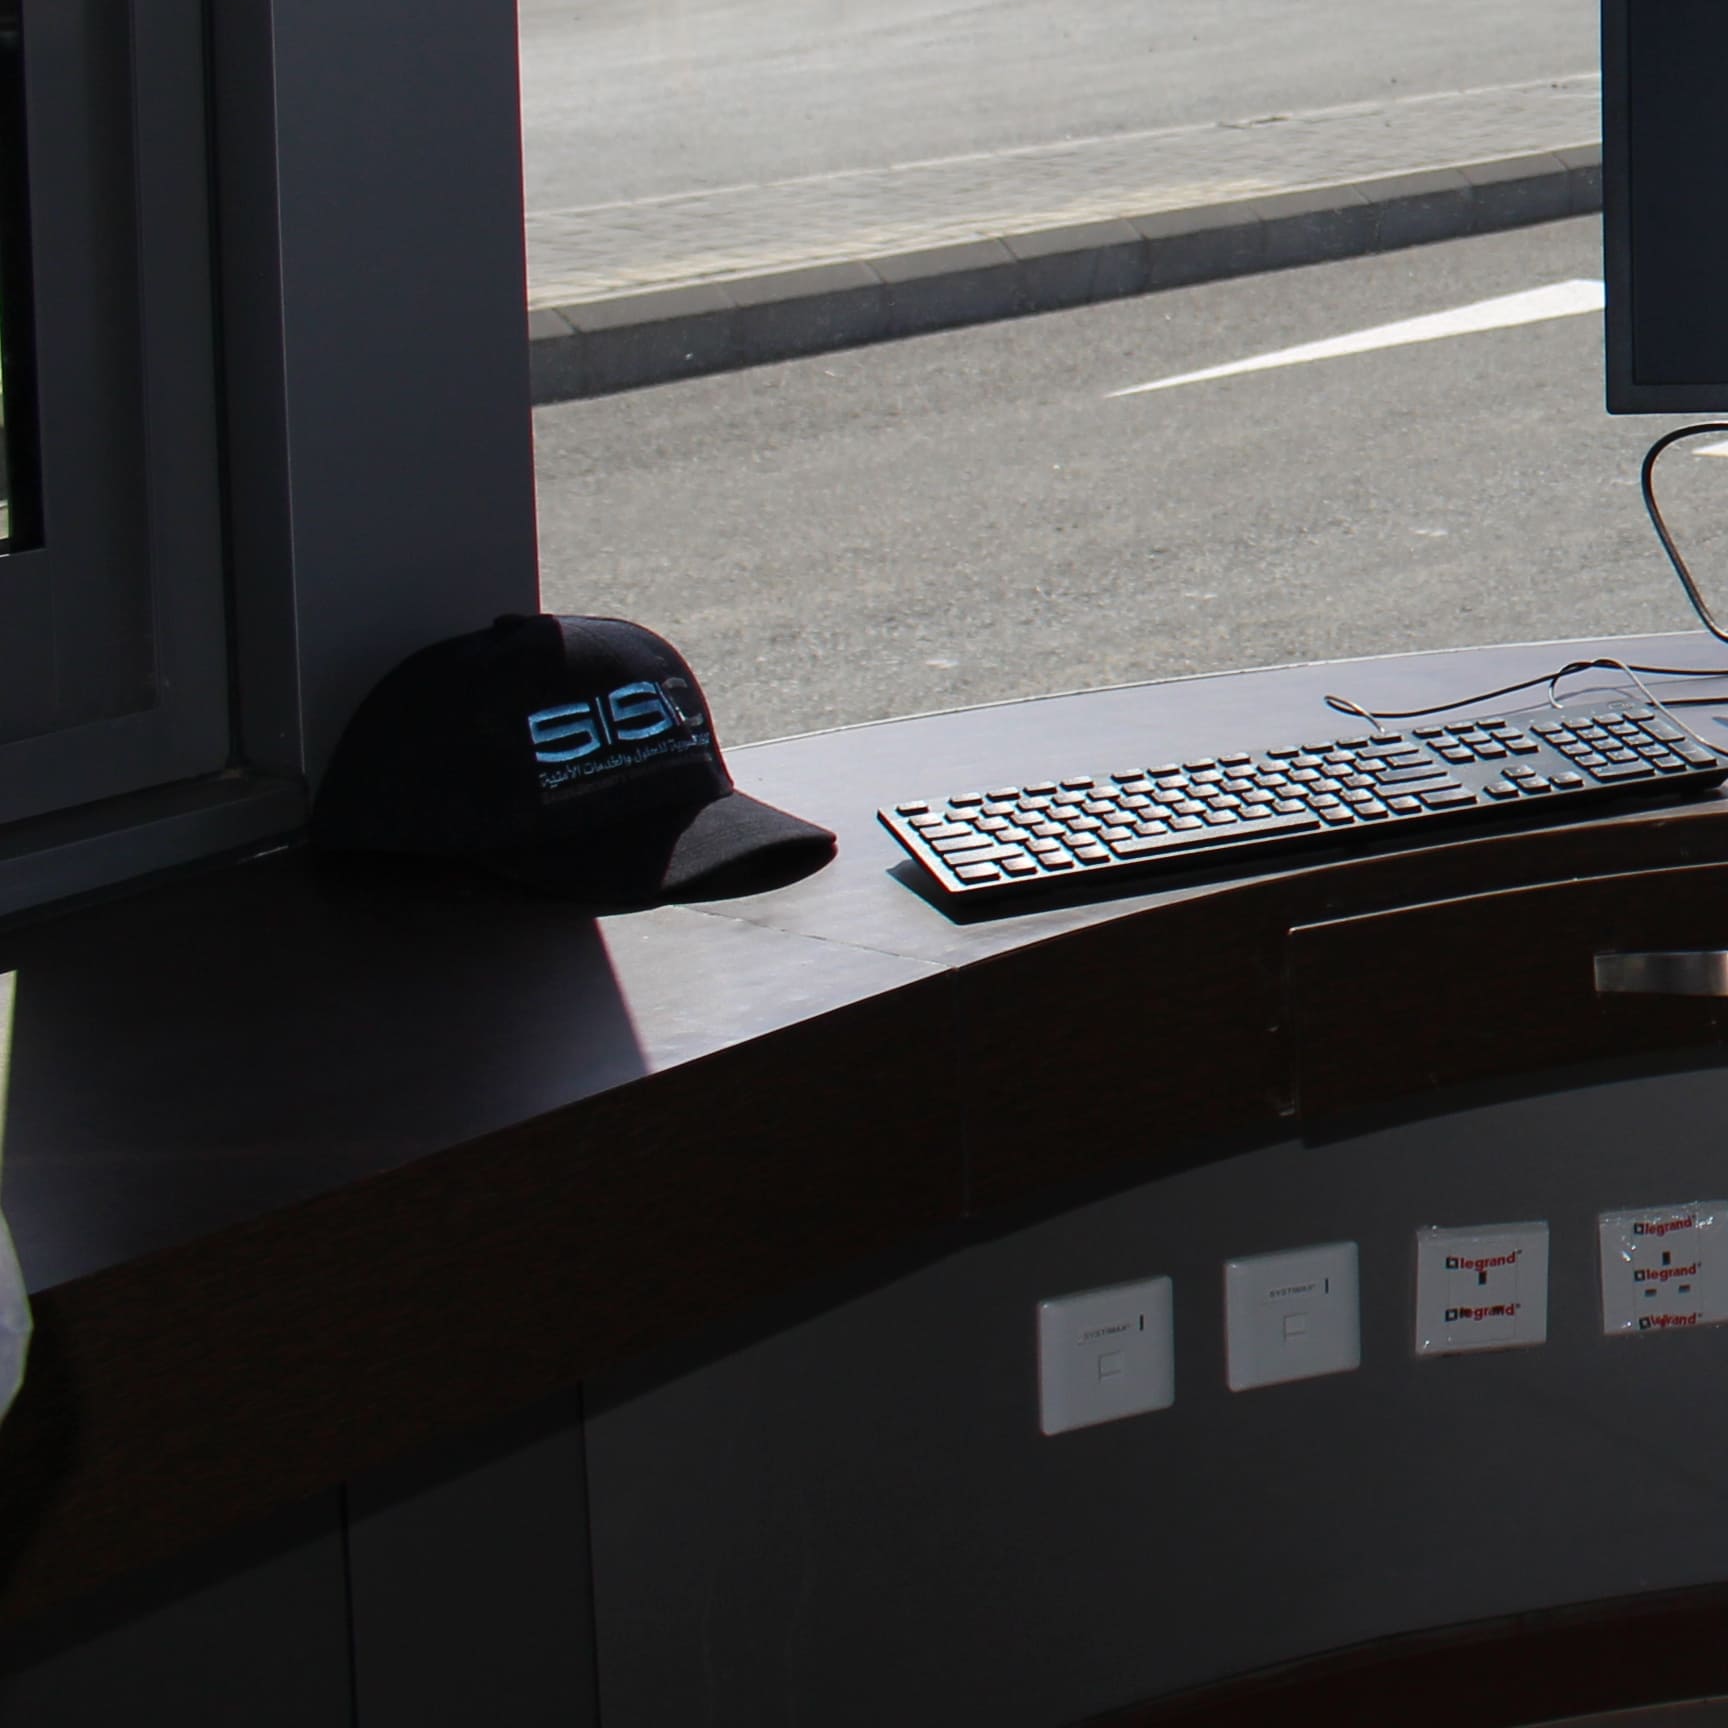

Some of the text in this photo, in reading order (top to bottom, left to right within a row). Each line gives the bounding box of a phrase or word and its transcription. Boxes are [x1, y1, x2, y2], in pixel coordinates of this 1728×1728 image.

[1645, 1216, 1692, 1236] legrand
[1460, 1251, 1516, 1271] legrand
[1646, 1263, 1697, 1281] legrand
[1459, 1303, 1514, 1320] legrand
